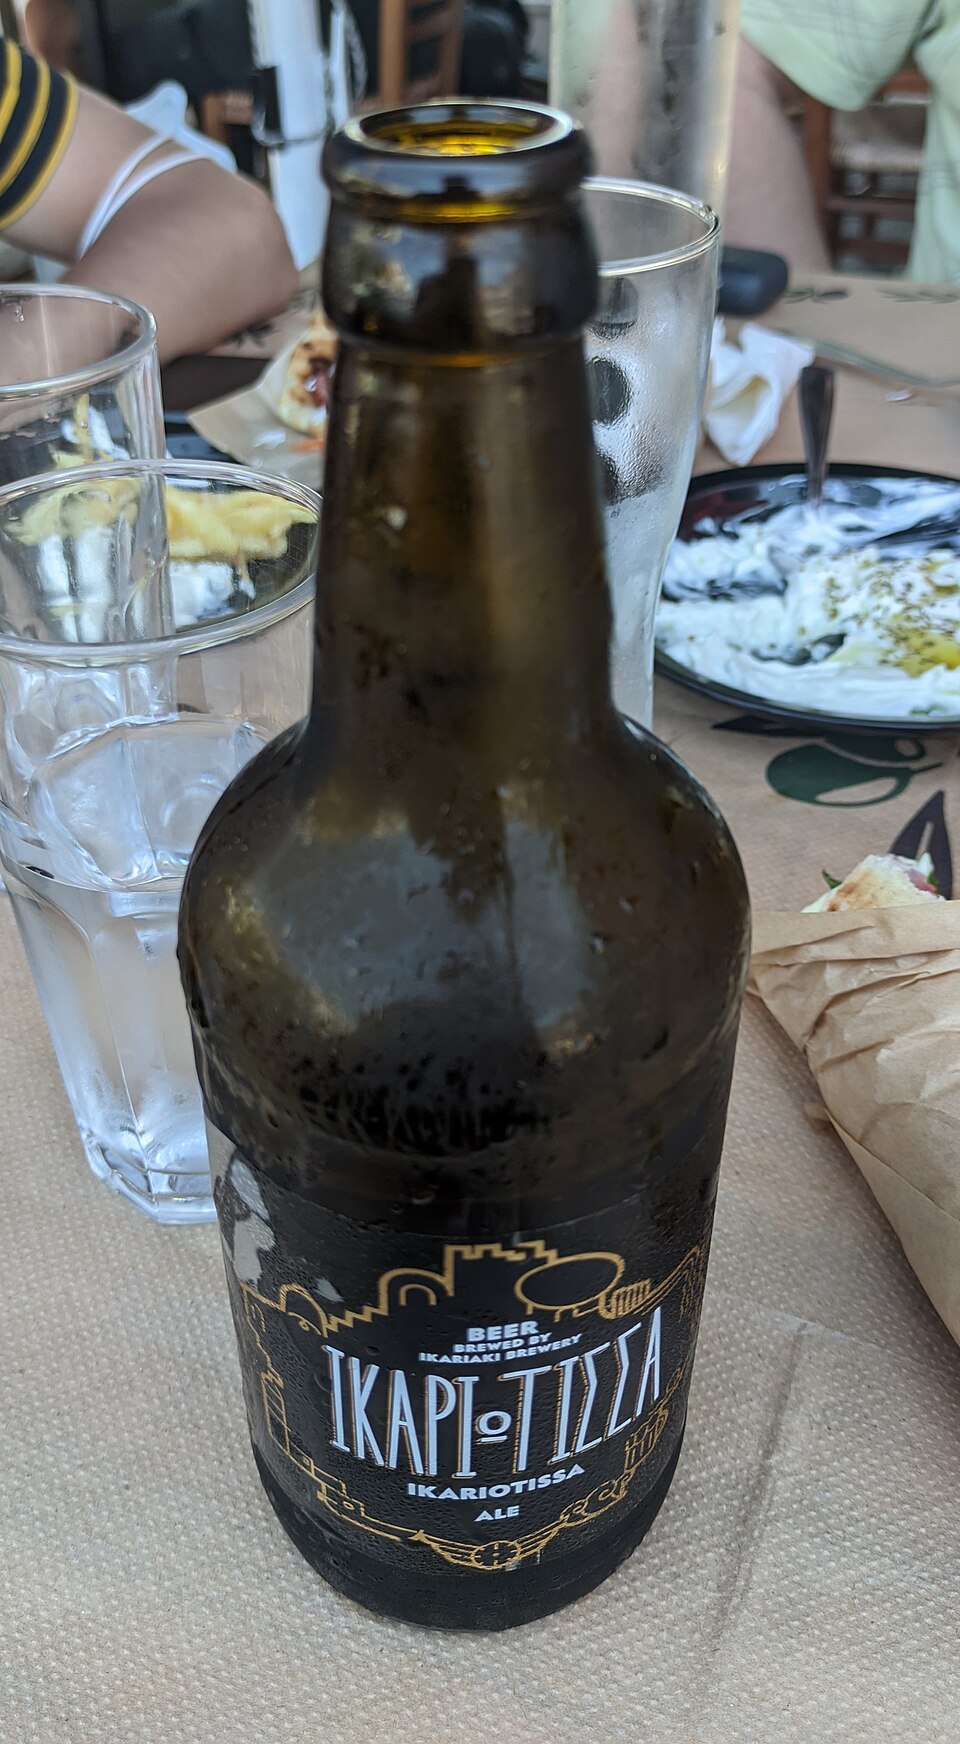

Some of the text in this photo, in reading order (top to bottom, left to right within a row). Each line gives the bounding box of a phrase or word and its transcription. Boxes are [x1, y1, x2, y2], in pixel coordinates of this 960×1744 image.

[453, 1331, 552, 1354] BREWED BY
[467, 1320, 539, 1342] BEER
[418, 1333, 583, 1364] IKARIAKI BREWERY
[406, 1464, 586, 1500] IKARIOTISSA
[474, 1506, 520, 1523] ALE
